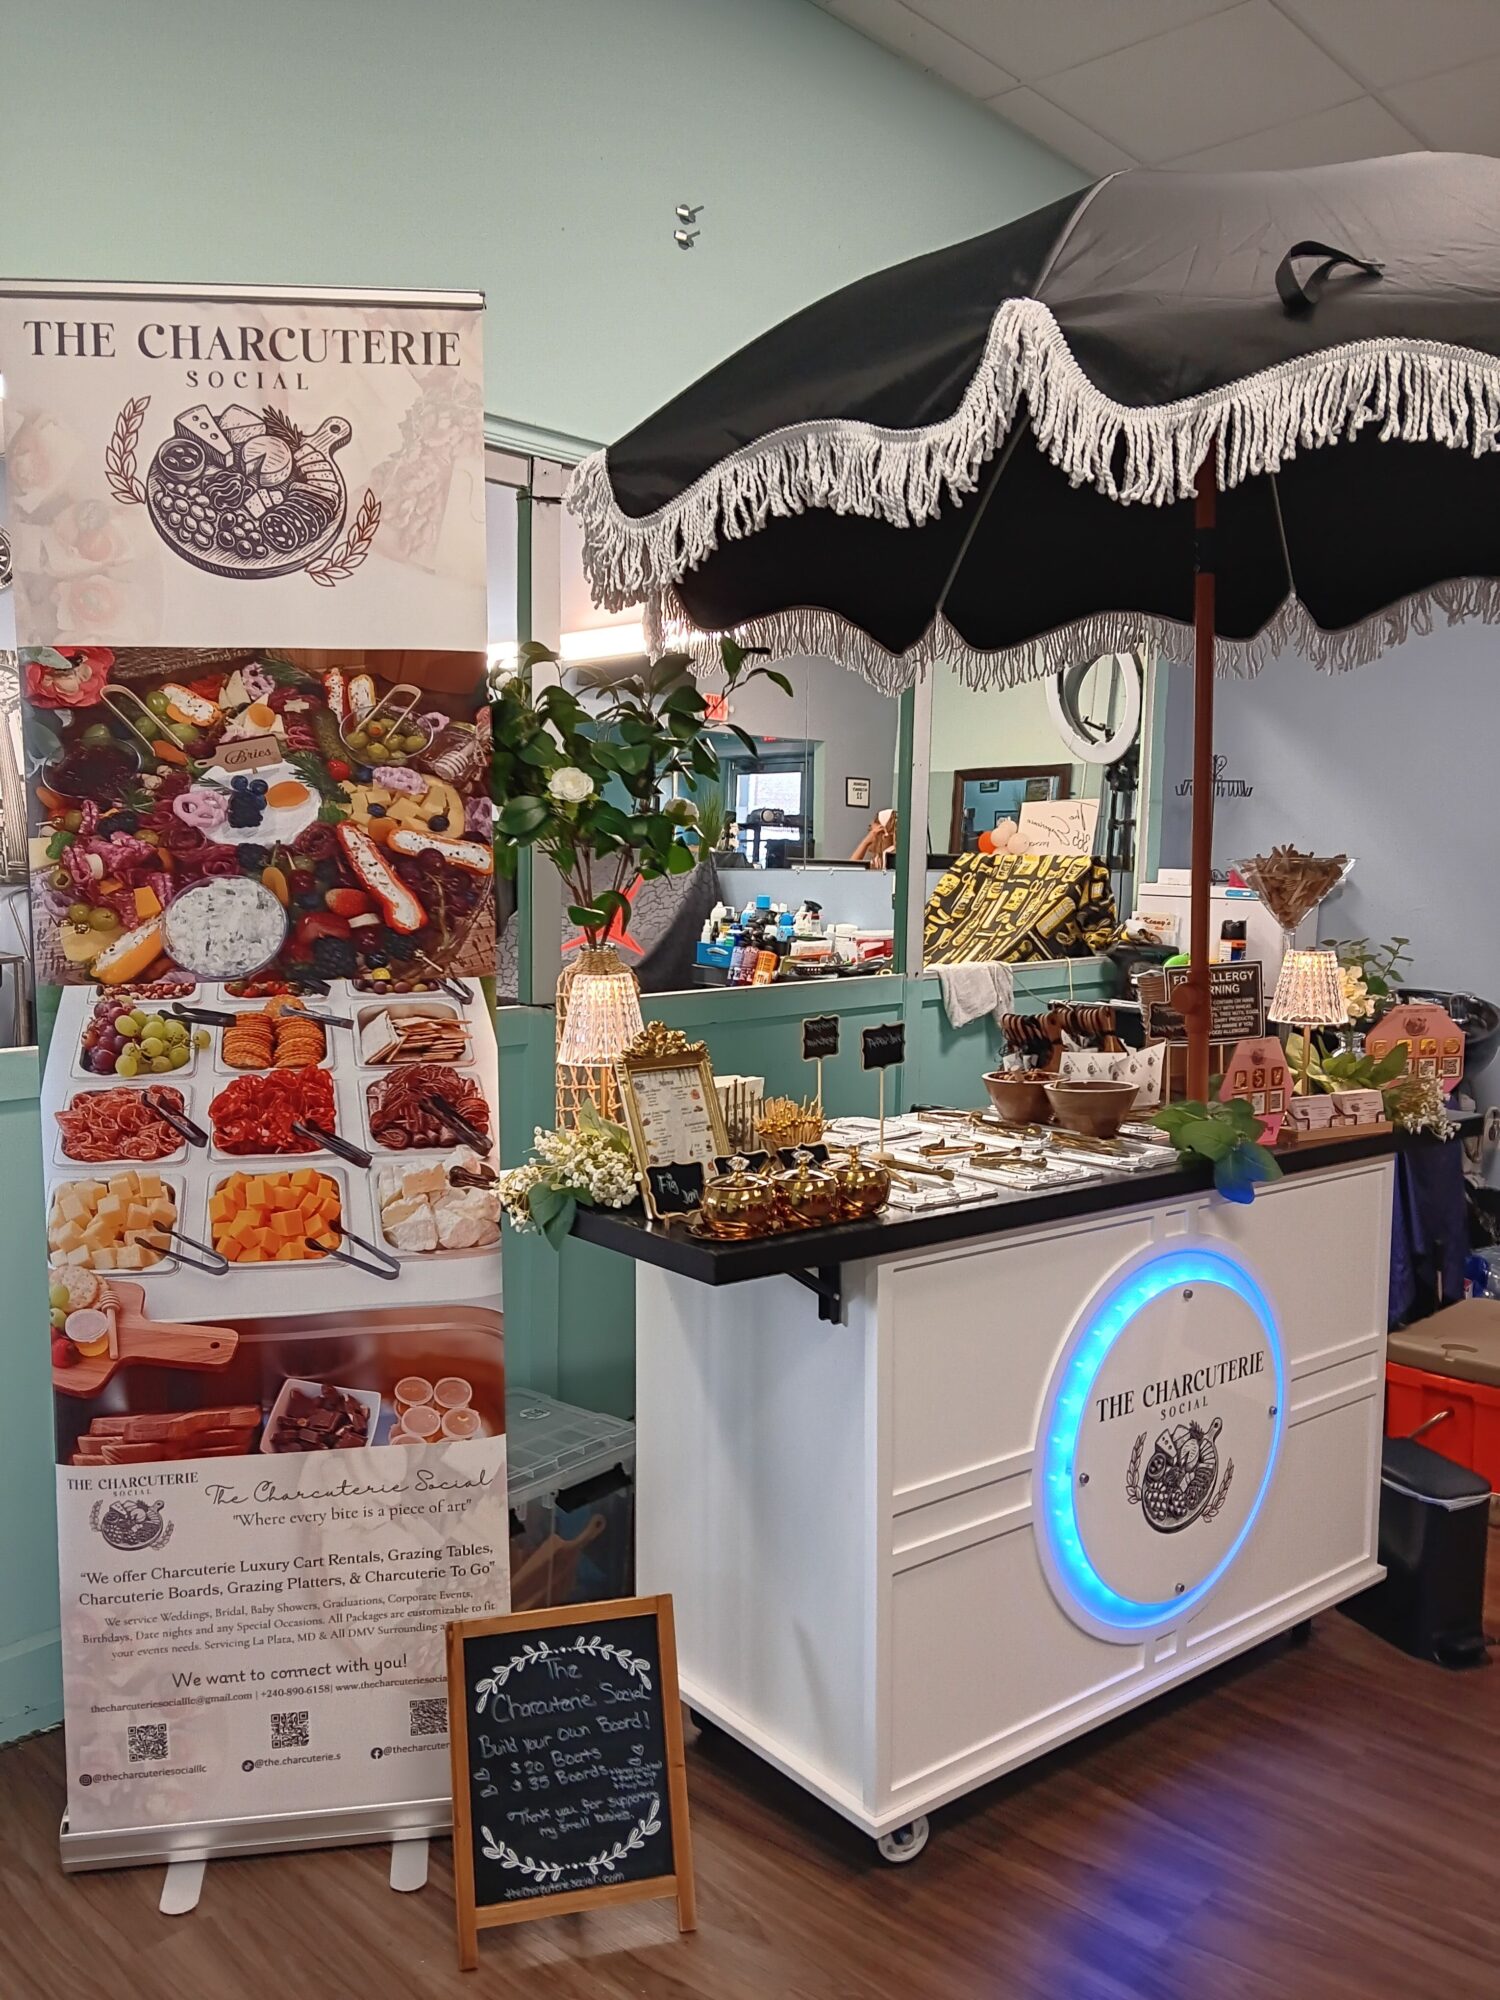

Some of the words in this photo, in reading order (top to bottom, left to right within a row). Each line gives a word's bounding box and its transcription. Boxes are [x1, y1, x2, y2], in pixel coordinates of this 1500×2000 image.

[23, 320, 116, 357] THE
[137, 323, 462, 367] CHARCUTERIE
[185, 370, 309, 391] SOCIAL
[224, 747, 272, 764] Bries
[1210, 970, 1254, 983] LLERGY
[1209, 983, 1240, 995] RNING
[656, 1172, 680, 1195] Fig
[1096, 1390, 1135, 1423] THE
[1142, 1350, 1265, 1408] CHARCUTERIE
[1160, 1395, 1208, 1421] SOCIAL
[67, 1479, 93, 1490] THE
[98, 1471, 199, 1490] CHARCUTERIE
[205, 1484, 249, 1505] The
[253, 1480, 409, 1504] Charcuterie
[414, 1469, 494, 1492] Social
[113, 1489, 152, 1497] SOCIAL
[233, 1512, 285, 1526] "Where
[290, 1511, 327, 1526] every
[331, 1507, 359, 1520] bite
[363, 1506, 374, 1518] is
[378, 1508, 385, 1517] a
[389, 1503, 425, 1520] piece
[429, 1500, 444, 1513] of
[447, 1498, 472, 1512] art"
[113, 1570, 147, 1583] offer
[151, 1561, 236, 1580] Charcuterie
[240, 1559, 290, 1573] Luxury
[293, 1555, 324, 1569] Cart
[328, 1550, 385, 1566] Rentals,
[388, 1547, 442, 1562] Grazing
[446, 1543, 494, 1558] Tables,
[79, 1589, 164, 1606] Charcuterie
[168, 1583, 223, 1599] Boards,
[227, 1580, 284, 1595] Grazing
[287, 1575, 345, 1591] Platters,
[349, 1572, 361, 1585] &
[365, 1567, 446, 1583] Charcuterie
[450, 1564, 466, 1577] To
[105, 1617, 120, 1627] We
[123, 1615, 158, 1626] service
[160, 1611, 213, 1625] Weddings,
[215, 1606, 248, 1618] Bridal,
[251, 1604, 274, 1617] Baby
[277, 1602, 320, 1614] Showers,
[322, 1595, 385, 1610] Graduations,
[387, 1592, 437, 1605] Corporate
[439, 1589, 474, 1601] Events,
[82, 1632, 133, 1646] Birthdays,
[136, 1630, 159, 1641] Date
[162, 1627, 193, 1641] nights
[195, 1624, 214, 1635] and
[216, 1624, 234, 1636] any
[237, 1619, 271, 1633] Special
[274, 1616, 325, 1630] Occasions.
[328, 1613, 344, 1625] All
[346, 1610, 388, 1625] Packages
[390, 1610, 405, 1620] are
[407, 1604, 469, 1618] customizable
[471, 1604, 482, 1613] to
[484, 1600, 496, 1611] fit
[111, 1649, 134, 1662] your
[137, 1646, 168, 1657] events
[171, 1642, 201, 1654] needs.
[204, 1637, 250, 1651] Servicing
[252, 1635, 265, 1646] La
[267, 1633, 295, 1645] Plata,
[297, 1630, 316, 1642] MD
[318, 1629, 328, 1640] &
[330, 1627, 345, 1640] All
[348, 1626, 375, 1637] DMV
[377, 1621, 438, 1636] Surrounding
[172, 1672, 201, 1688] We
[206, 1670, 246, 1685] want
[250, 1669, 265, 1682] to
[270, 1663, 332, 1680] connect
[336, 1657, 370, 1675] with
[374, 1653, 408, 1676] you!
[538, 1657, 583, 1680] The
[335, 1675, 448, 1693] www.thecharcuteriesocia
[600, 1682, 651, 1704] Social
[478, 1734, 519, 1759] Build
[522, 1735, 552, 1754] your
[556, 1725, 592, 1741] own
[596, 1710, 651, 1733] Board!
[254, 1752, 341, 1769] @the.charcuterie.s
[383, 1742, 451, 1756] @thecharcuter
[551, 1747, 602, 1768] Boats
[554, 1764, 609, 1786] Boards
[506, 1807, 551, 1826] Thank
[555, 1805, 580, 1823] you
[581, 1798, 603, 1815] for
[538, 1825, 559, 1840] my
[559, 1816, 591, 1834] small
